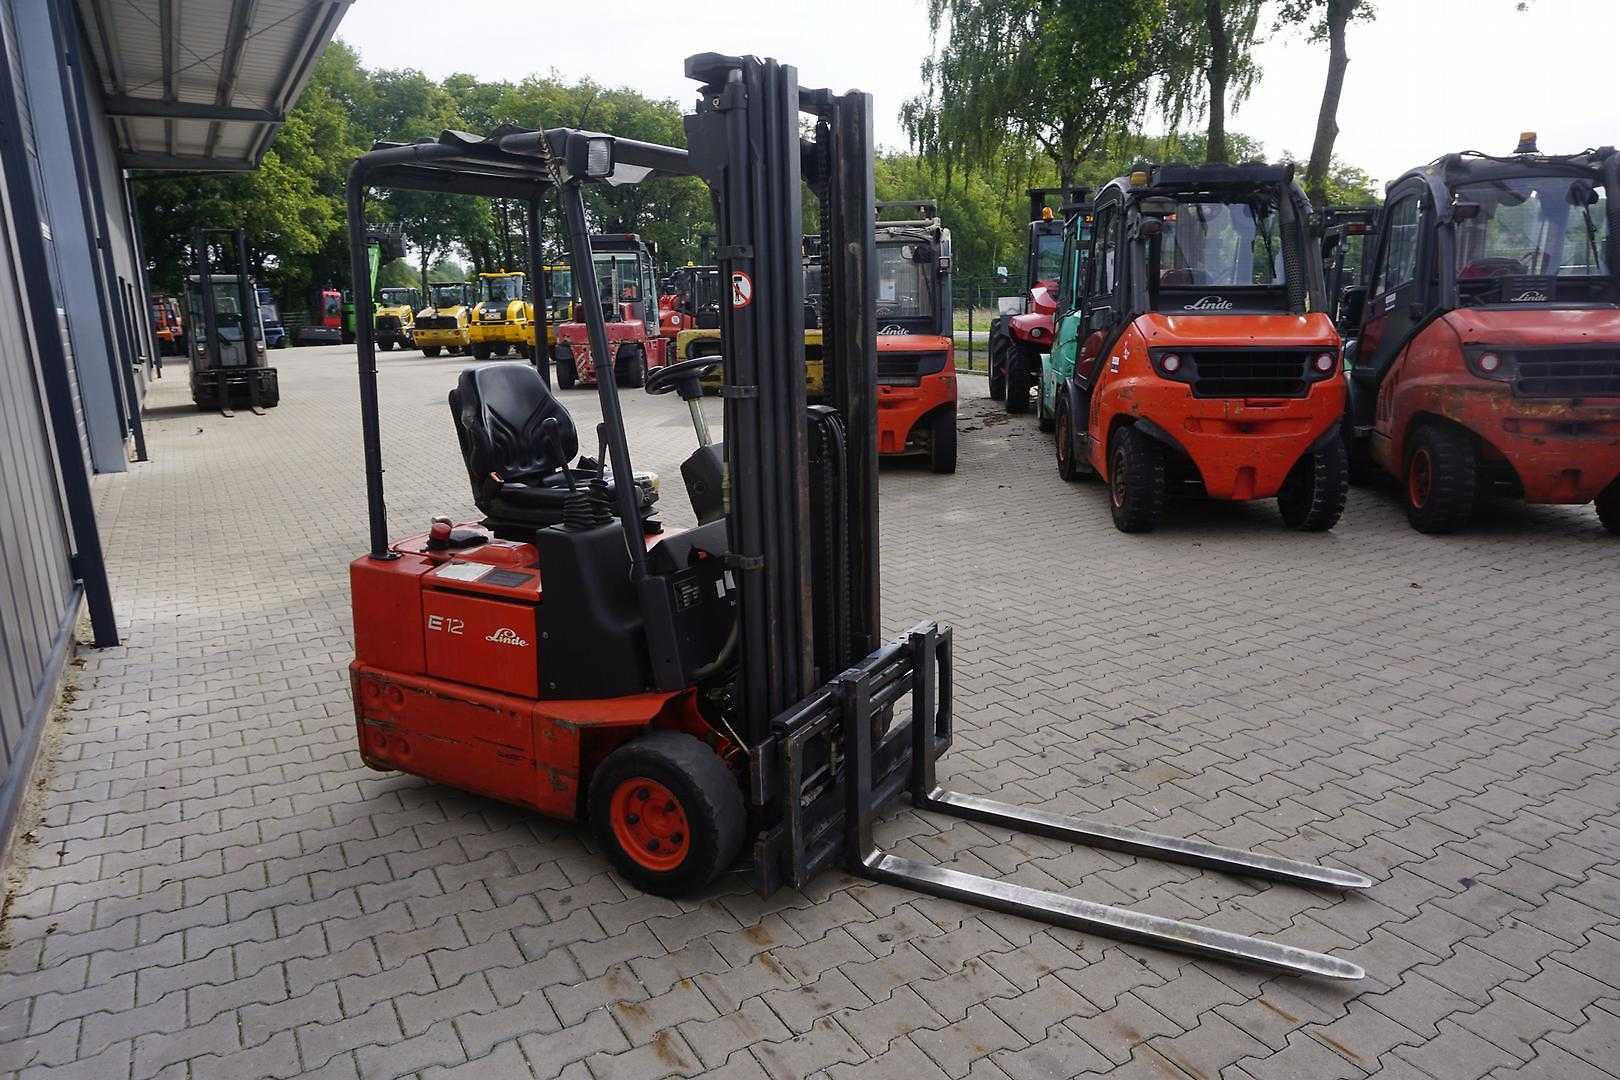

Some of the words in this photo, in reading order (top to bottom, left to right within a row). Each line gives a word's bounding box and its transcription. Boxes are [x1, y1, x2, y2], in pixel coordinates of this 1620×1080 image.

[1183, 295, 1233, 310] Linde
[1511, 290, 1547, 302] Linde
[877, 324, 911, 336] Linde
[485, 627, 529, 647] Linde
